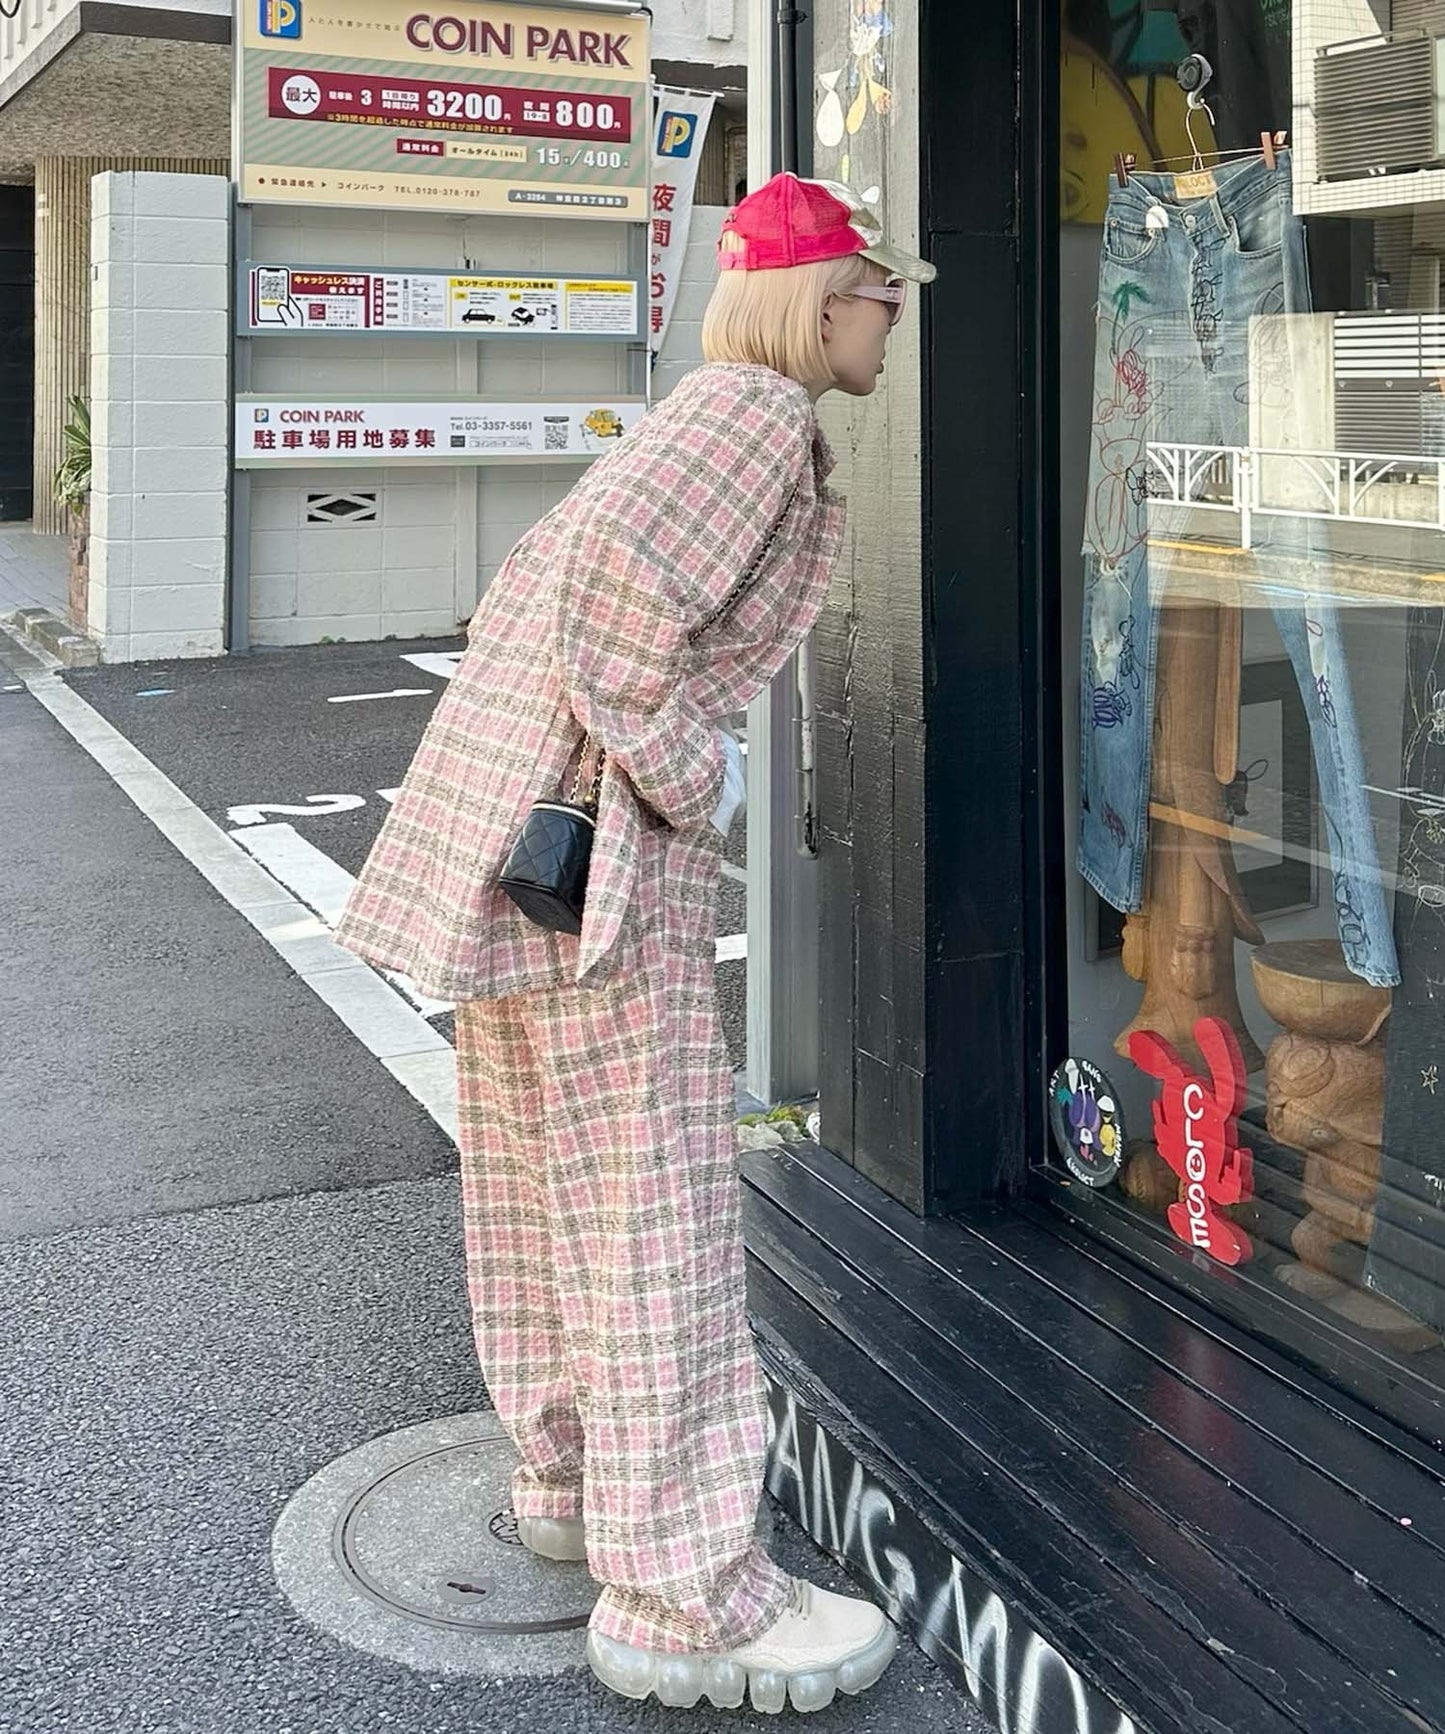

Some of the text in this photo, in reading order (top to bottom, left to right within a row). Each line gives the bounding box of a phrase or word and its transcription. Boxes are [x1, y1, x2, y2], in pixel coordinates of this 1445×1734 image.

[406, 14, 633, 68] COIN PARK
[286, 87, 317, 104] 最大
[360, 89, 373, 106] 3
[337, 182, 385, 191] コインパーク
[294, 275, 365, 286] キャッシュレス決済
[280, 410, 365, 423] COIN PARK
[254, 429, 436, 449] 駐車場用地募集
[1183, 1083, 1211, 1249] CLOSE
